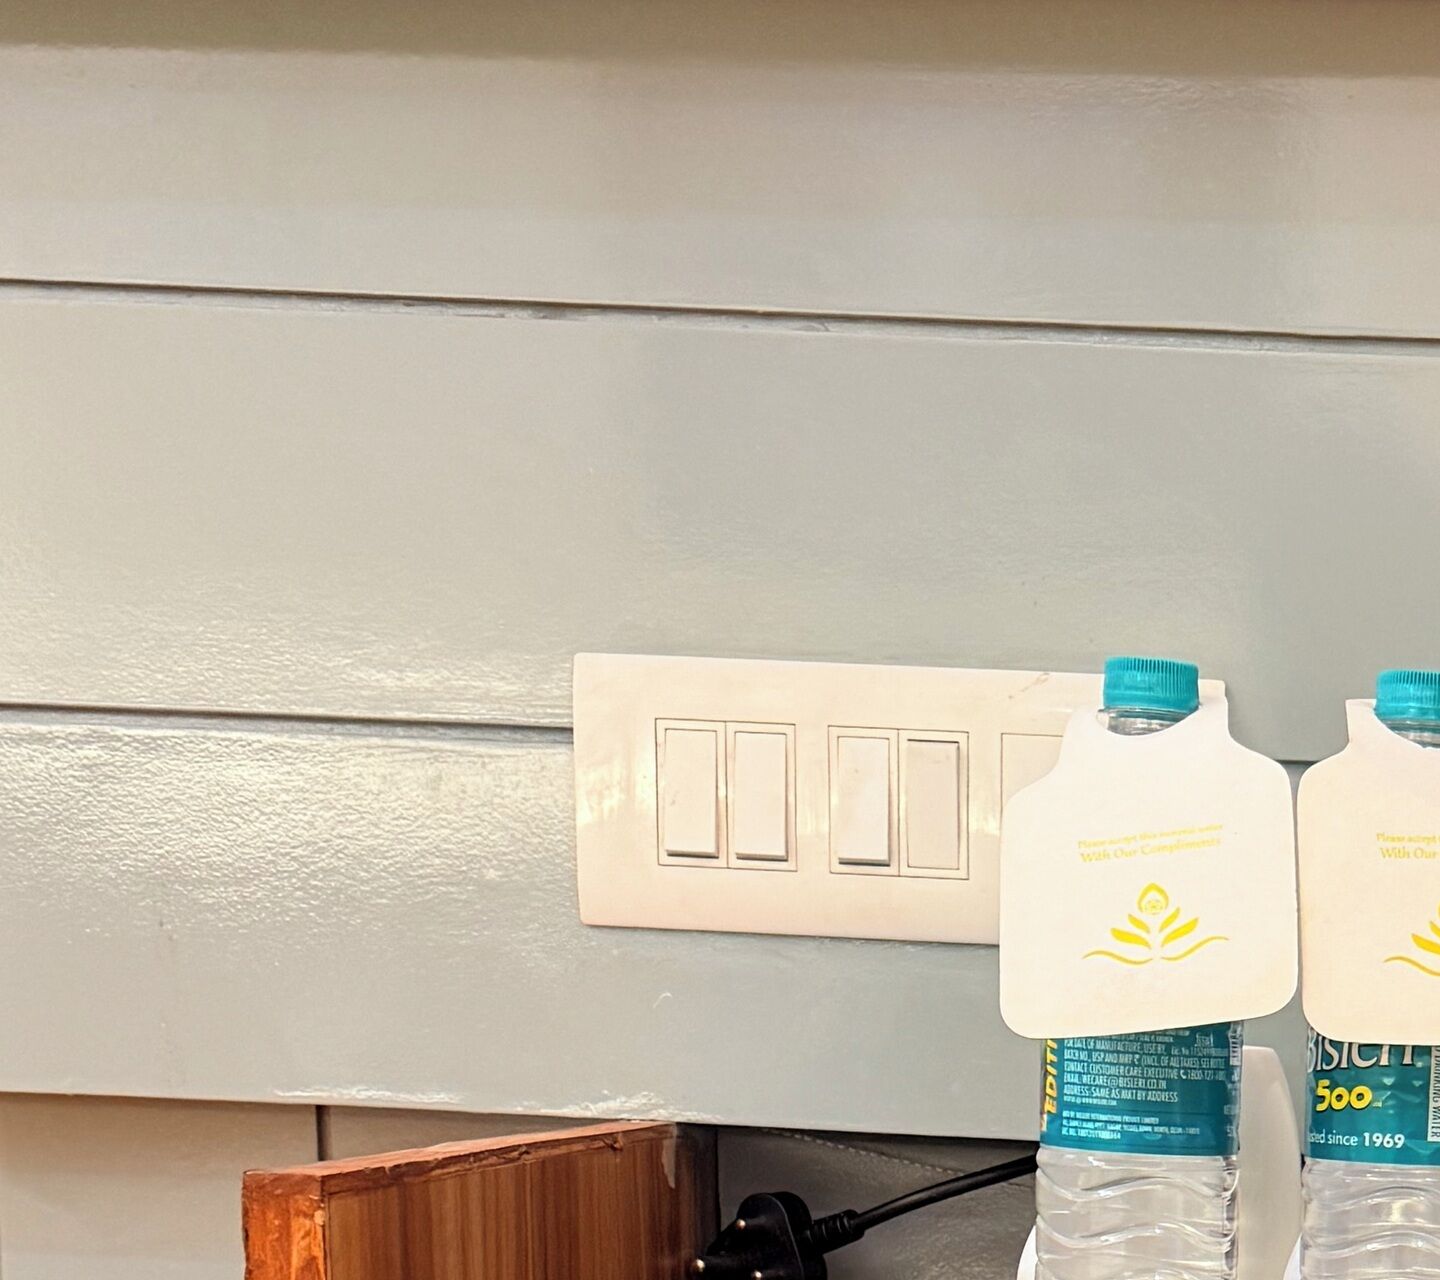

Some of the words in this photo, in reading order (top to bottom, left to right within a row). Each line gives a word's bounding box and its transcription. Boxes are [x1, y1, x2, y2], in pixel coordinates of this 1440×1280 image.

[1080, 849, 1111, 863] With
[1113, 848, 1137, 859] Our
[1379, 846, 1410, 860] With
[1413, 847, 1437, 860] Our
[1089, 1063, 1125, 1076] CUSTOMER
[1125, 1065, 1142, 1077] CARE
[1144, 1067, 1179, 1079] EXECUTIVE
[1092, 1086, 1110, 1098] SAME
[1110, 1087, 1120, 1099] AS
[1315, 1078, 1373, 1112] 500
[1327, 1129, 1359, 1146] since
[1363, 1132, 1405, 1149] 1969
